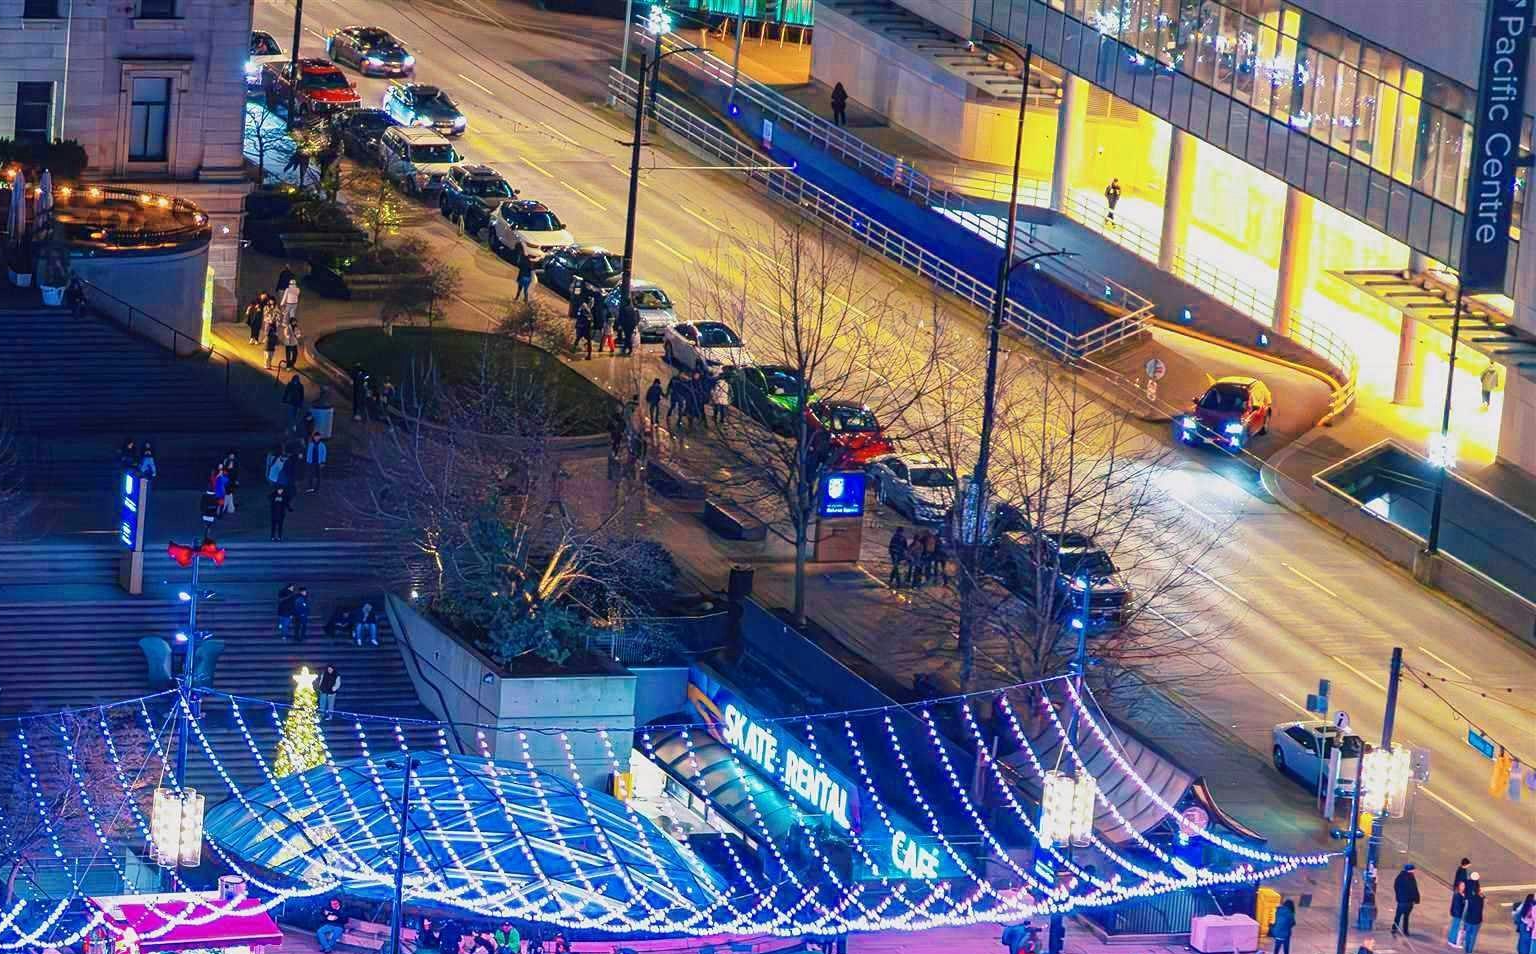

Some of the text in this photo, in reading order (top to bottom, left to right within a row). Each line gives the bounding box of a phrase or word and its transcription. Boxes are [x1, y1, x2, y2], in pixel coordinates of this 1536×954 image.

[1476, 16, 1525, 244] Pacific Centre
[724, 703, 852, 830] SKATE RENTAL
